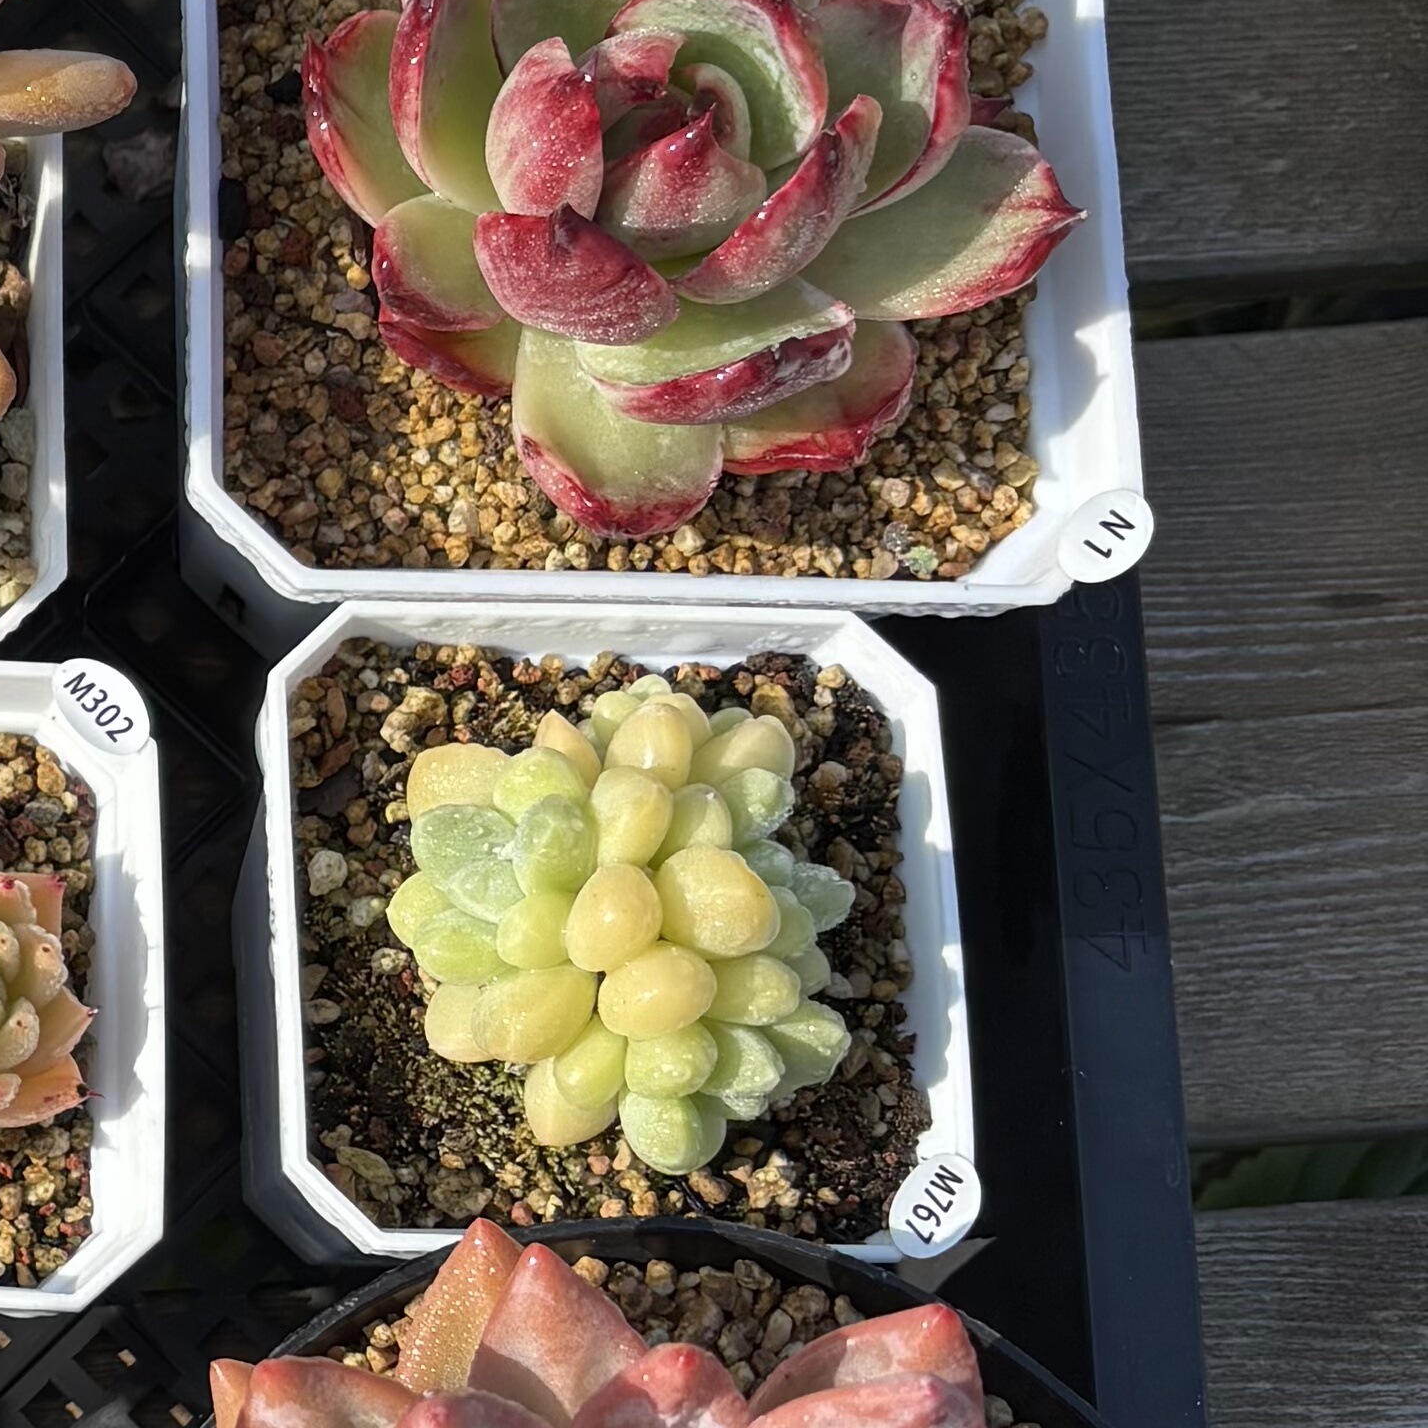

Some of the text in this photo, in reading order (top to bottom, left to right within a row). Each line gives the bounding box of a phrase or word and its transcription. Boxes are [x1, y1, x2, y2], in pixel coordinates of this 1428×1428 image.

[1083, 509, 1136, 559] N1
[63, 671, 134, 743] M302
[905, 1164, 964, 1245] M767
